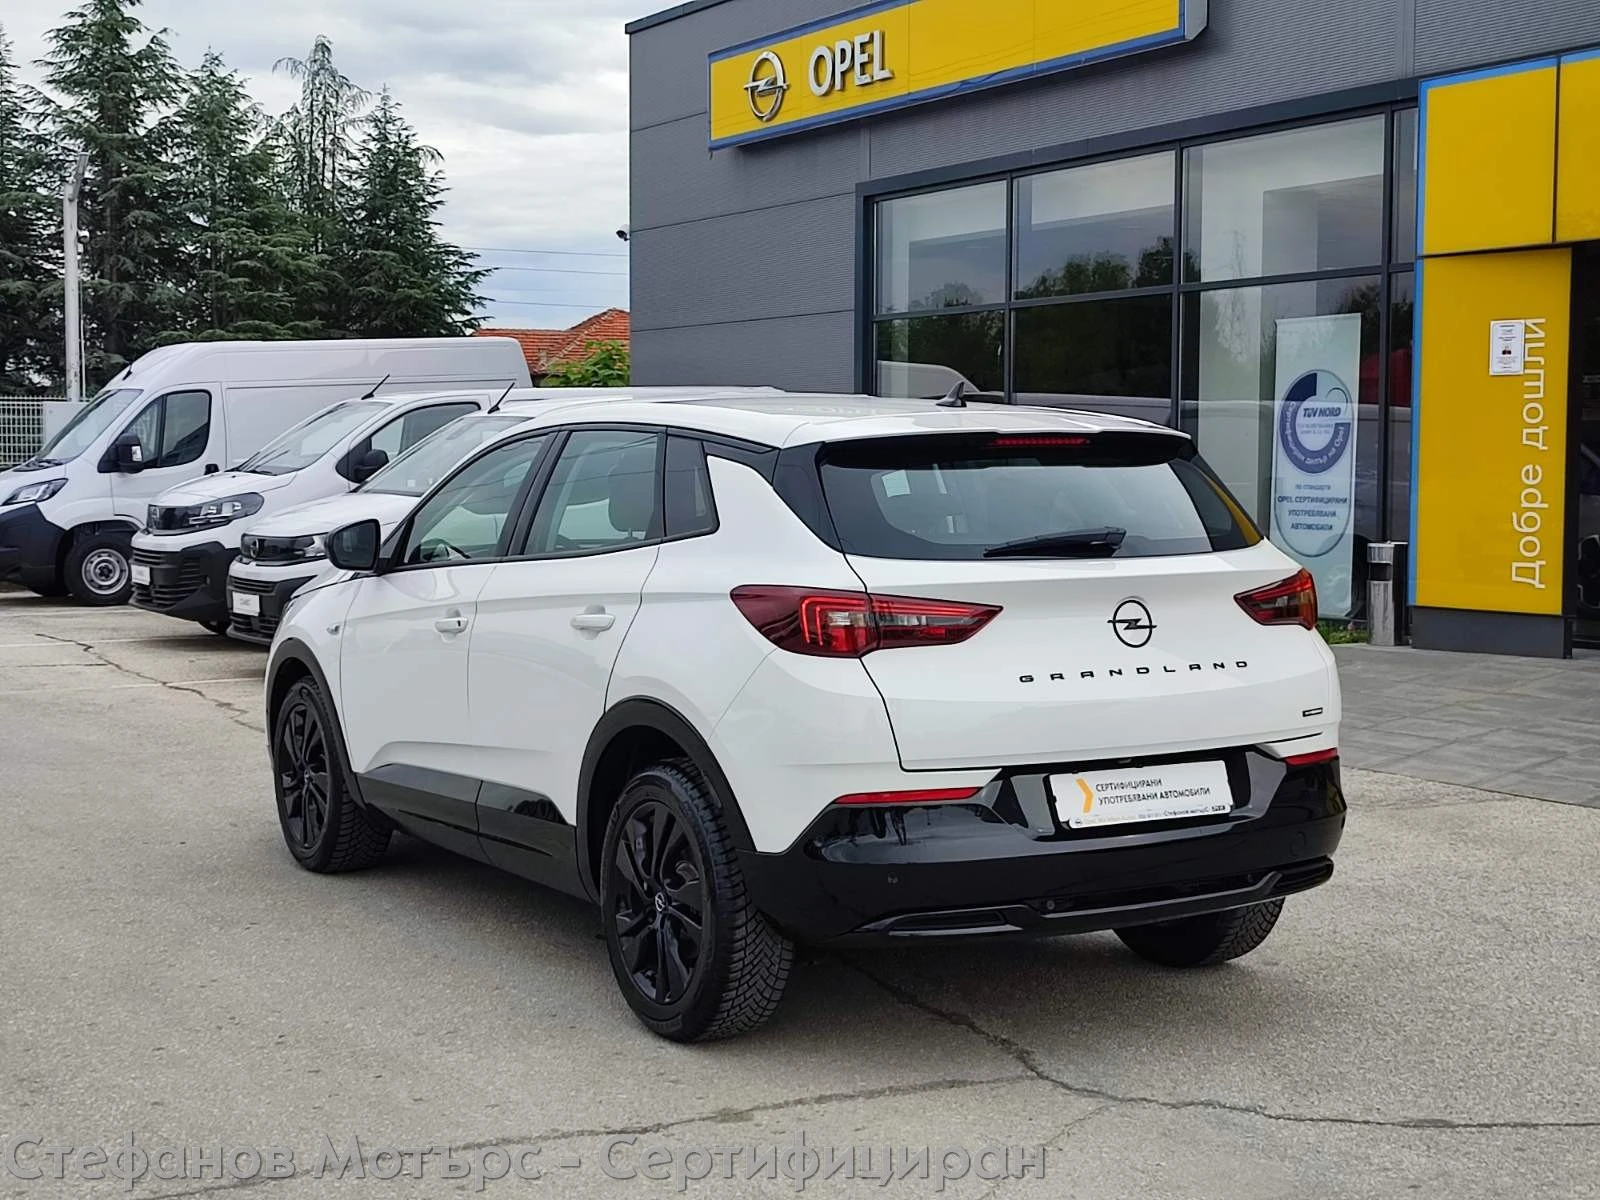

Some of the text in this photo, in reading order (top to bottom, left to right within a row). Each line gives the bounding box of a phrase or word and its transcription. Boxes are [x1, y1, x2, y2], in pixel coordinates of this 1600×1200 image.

[807, 30, 894, 97] OPEL
[1303, 407, 1342, 418] TÜV NORD
[1511, 317, 1549, 589] Добре дошли
[1277, 495, 1293, 503] OPEL
[1019, 659, 1249, 683] GRANDLAND
[1095, 778, 1162, 793] СЕРТИФИЦИРАНИ
[1098, 787, 1211, 805] УПОТРЕБЯВАНИ АВТОМОБИЛИ
